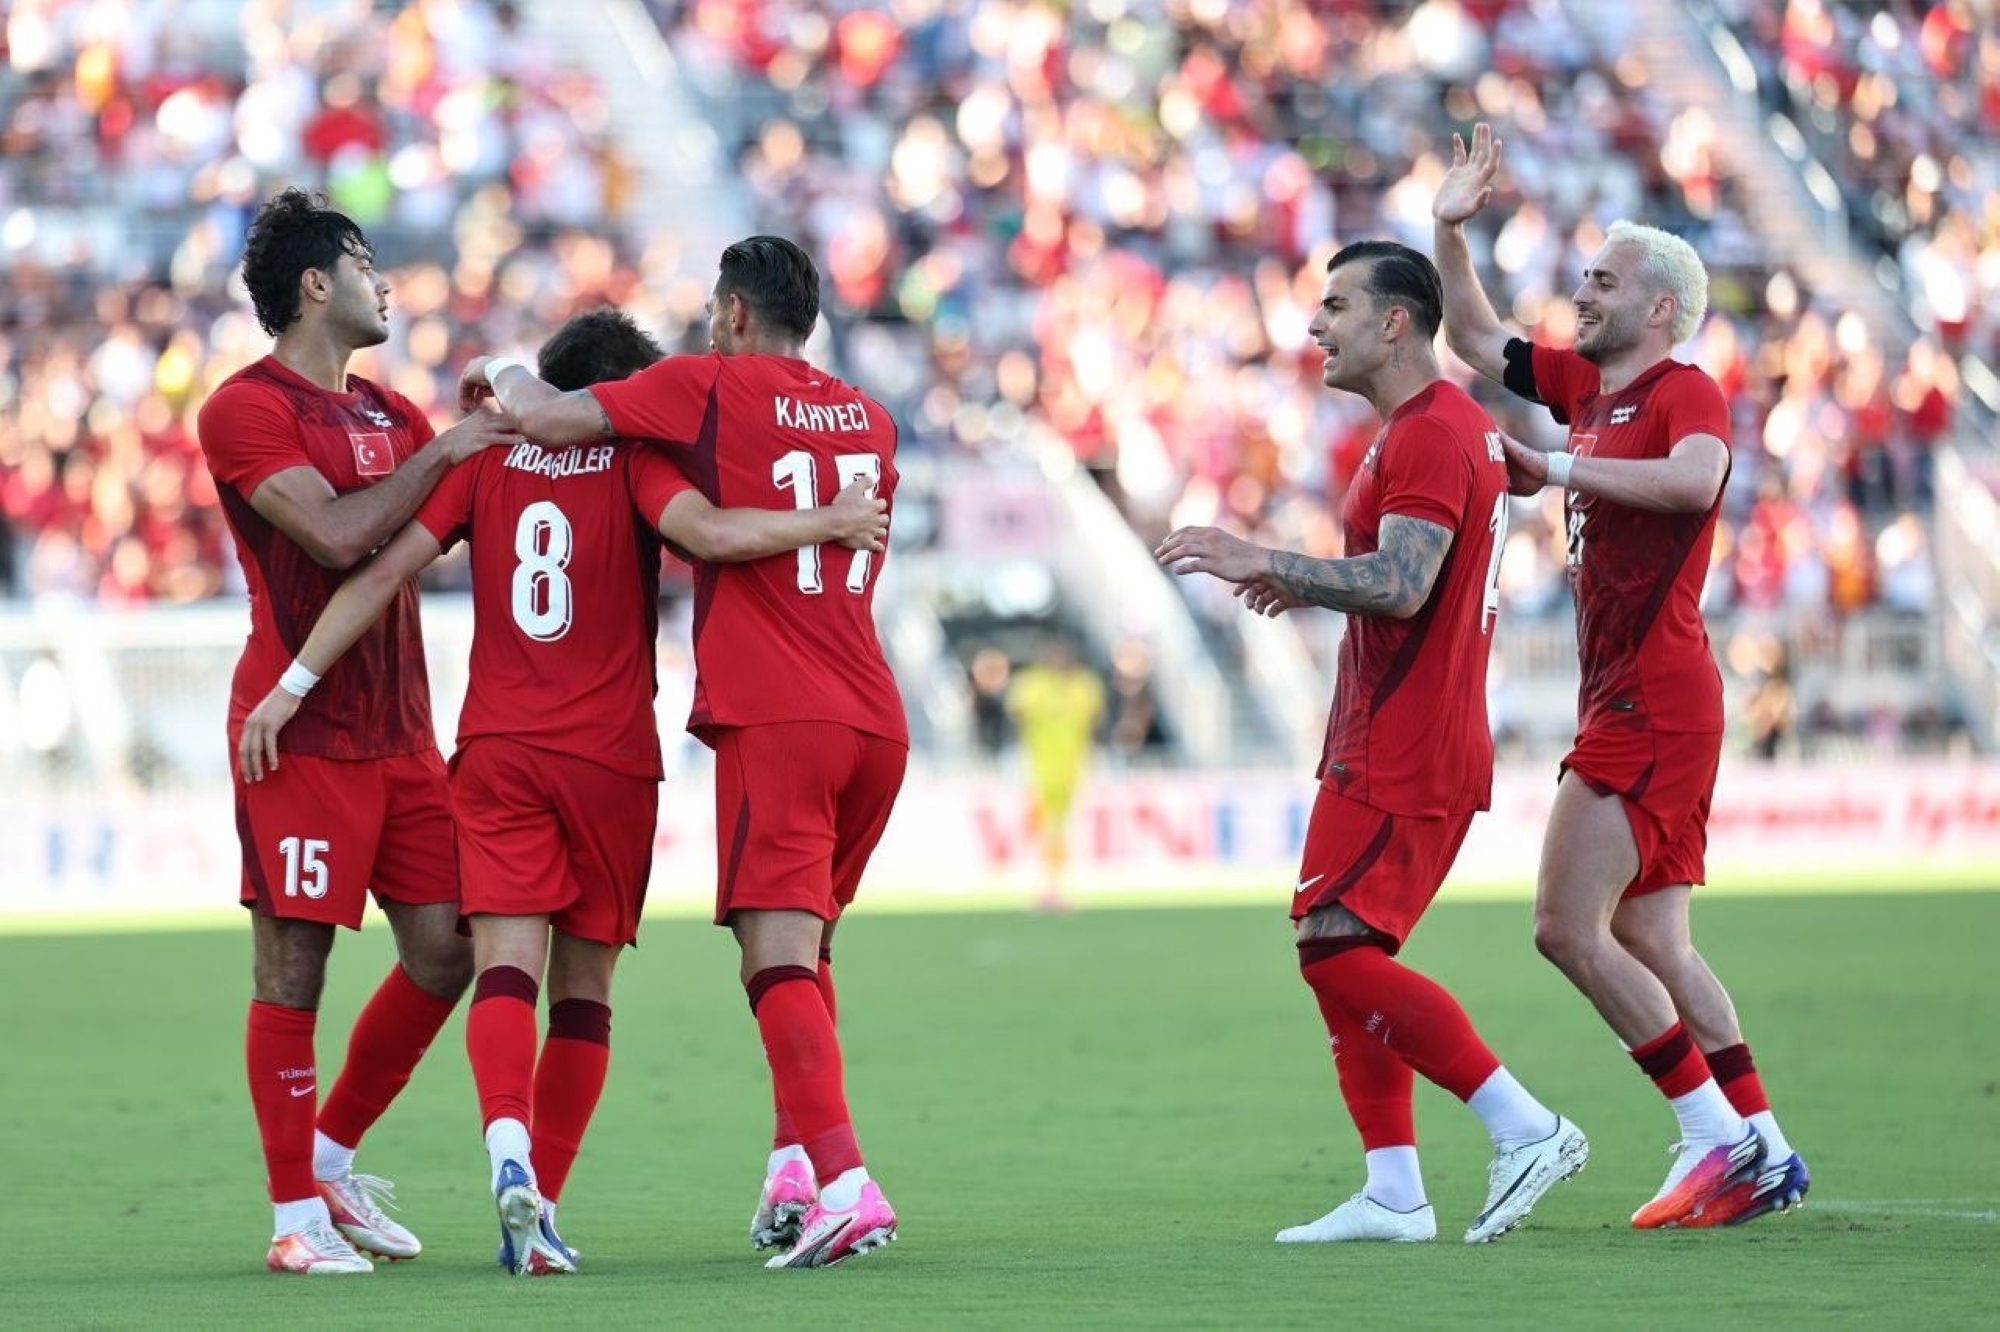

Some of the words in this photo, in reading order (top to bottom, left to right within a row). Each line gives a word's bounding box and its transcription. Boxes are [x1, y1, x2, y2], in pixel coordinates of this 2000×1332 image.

[512, 500, 573, 642] 8
[772, 450, 881, 595] 17
[279, 836, 330, 899] 15
